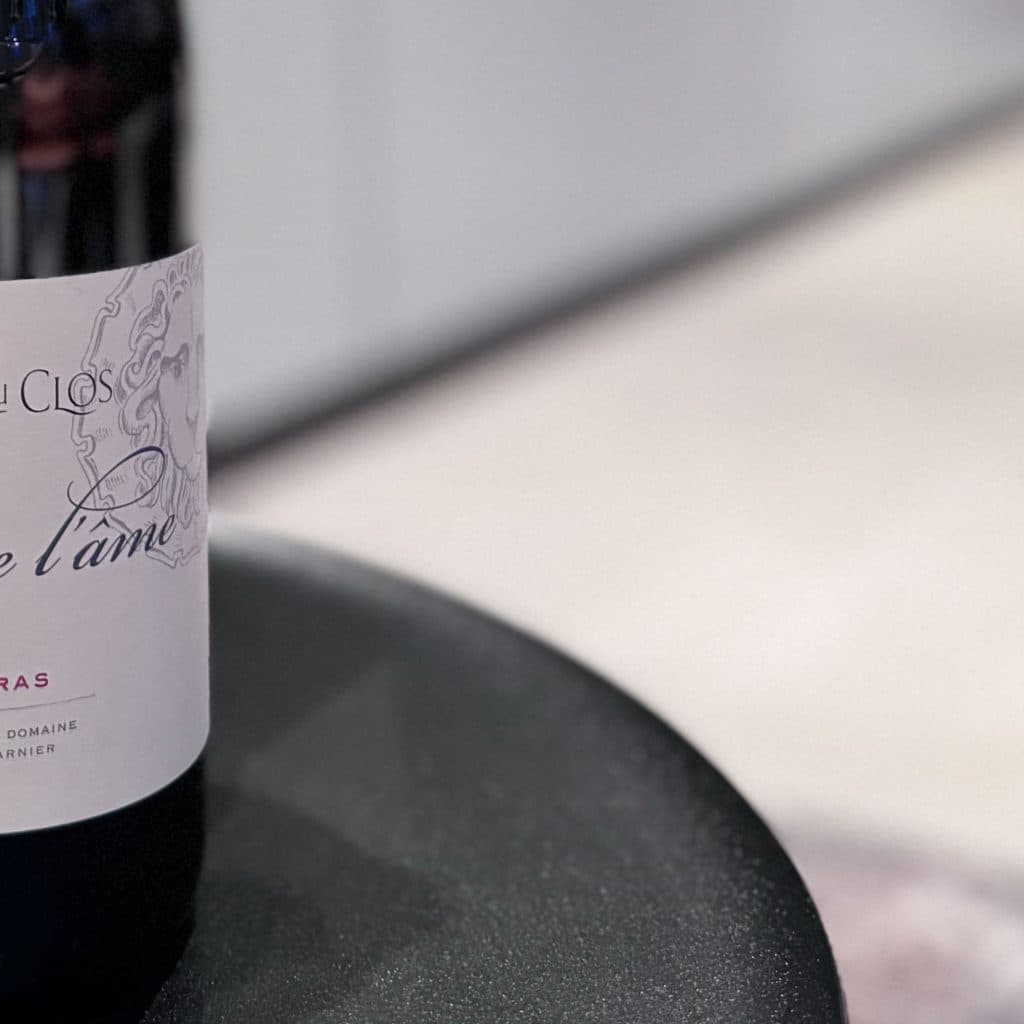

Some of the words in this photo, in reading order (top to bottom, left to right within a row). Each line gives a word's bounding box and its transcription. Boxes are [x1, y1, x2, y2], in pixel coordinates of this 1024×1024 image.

[20, 368, 113, 416] CLOS
[34, 445, 176, 577] l'âme
[7, 719, 78, 739] DOMAINE
